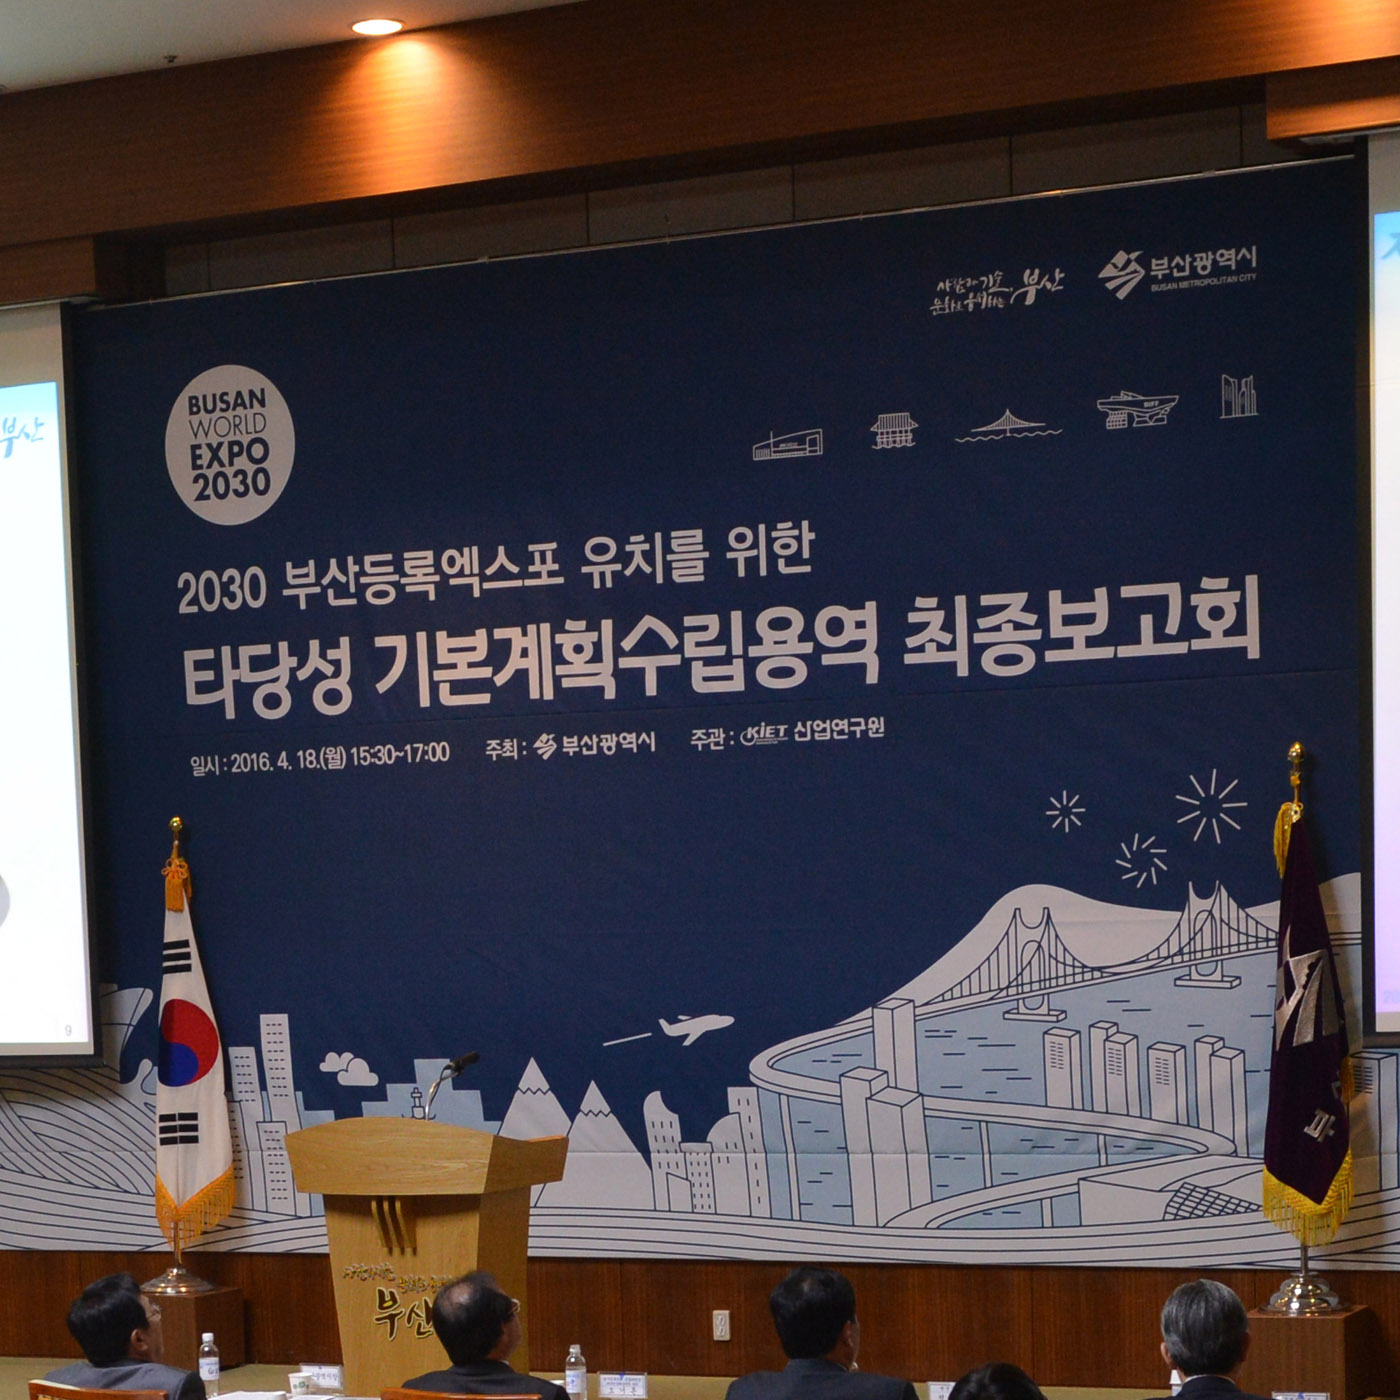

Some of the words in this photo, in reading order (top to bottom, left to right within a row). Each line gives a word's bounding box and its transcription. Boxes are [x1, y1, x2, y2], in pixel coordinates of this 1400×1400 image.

[1150, 246, 1257, 280] 부산광역시
[1010, 268, 1065, 305] 부산
[1151, 282, 1177, 292] BUSAN
[1178, 275, 1238, 291] METROPOLITAN
[1239, 273, 1257, 283] CITY
[188, 388, 266, 415] BUSAN
[189, 412, 267, 440] WORLD
[190, 437, 270, 470] EXPO
[192, 466, 271, 502] 2030
[178, 567, 267, 614] 2030
[283, 539, 565, 612] 부산등록엑스포
[580, 529, 710, 591] 유치를
[727, 519, 816, 581] 위한
[183, 634, 352, 722] 타당성
[375, 598, 881, 712] 기본계획수립용역
[903, 573, 1262, 675] 최종보고회
[561, 730, 657, 758] 부산광역시
[794, 717, 886, 742] 산업연구원
[231, 750, 275, 775] 2016.
[277, 748, 292, 772] 4.
[350, 741, 450, 768] 15:30~17:00
[374, 1287, 433, 1341] 부산
